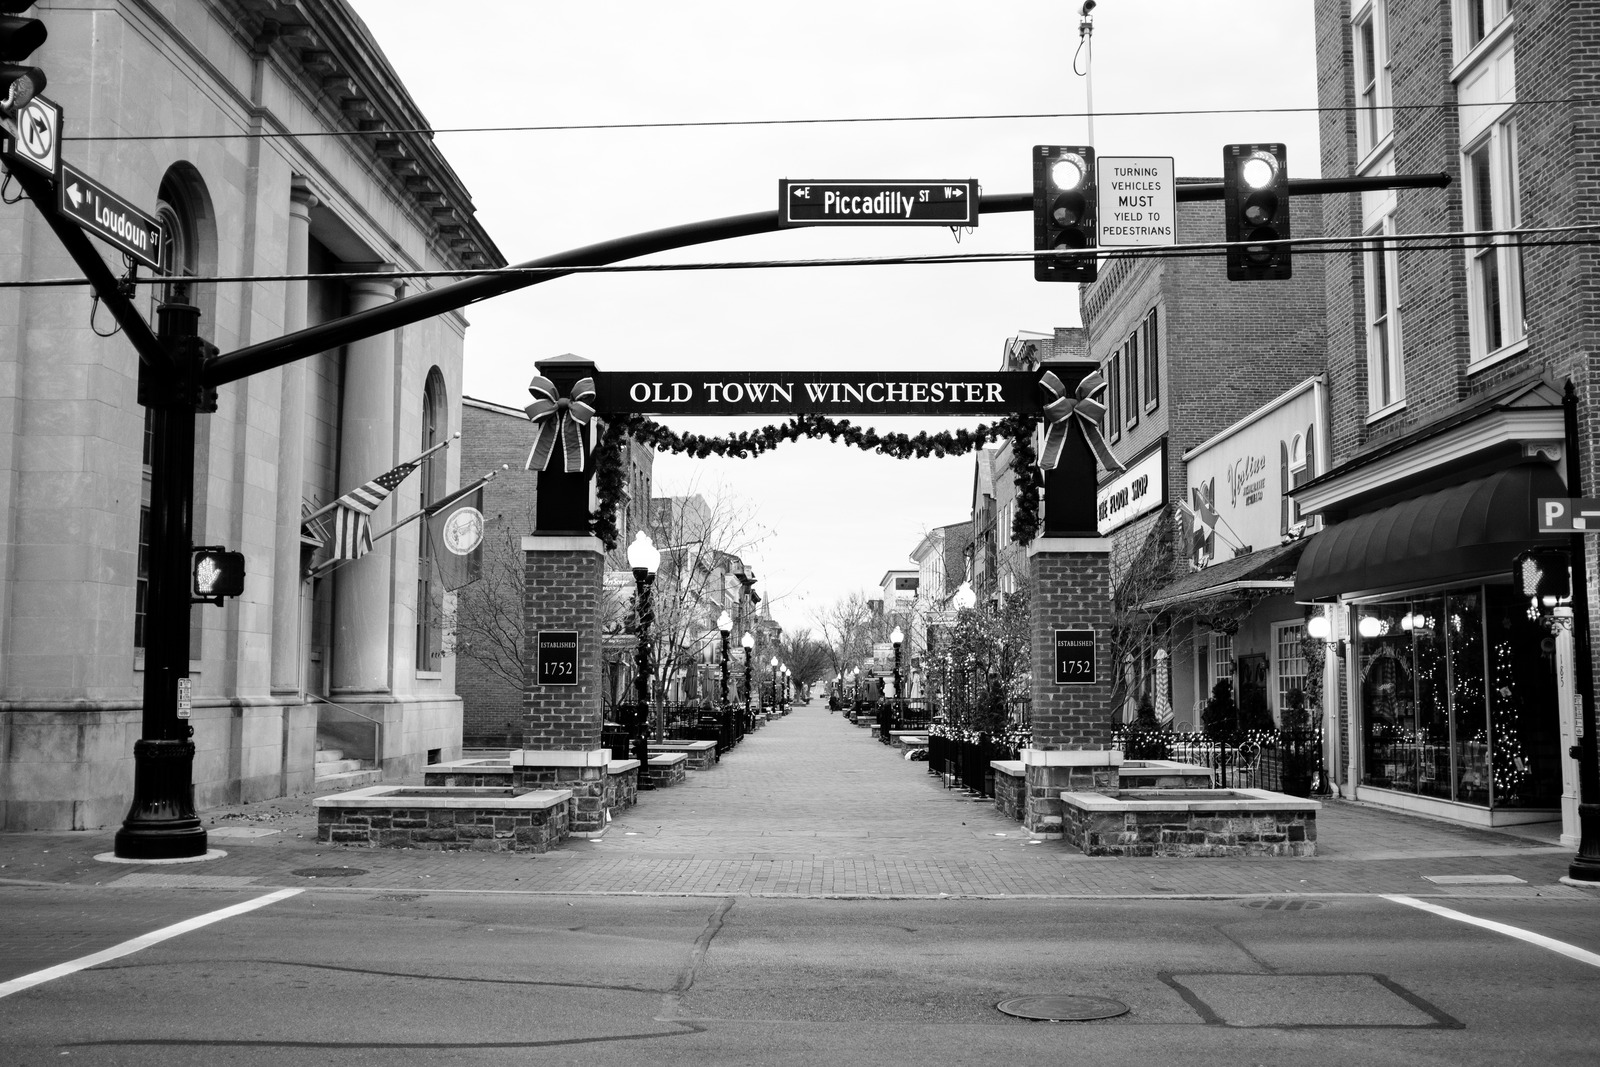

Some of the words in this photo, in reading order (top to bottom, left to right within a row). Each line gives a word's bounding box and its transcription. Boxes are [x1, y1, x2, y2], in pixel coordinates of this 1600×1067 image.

[1114, 167, 1158, 177] TURNING
[1111, 181, 1162, 191] VEHICLES
[805, 187, 810, 199] E
[824, 191, 915, 218] Piccadilly
[919, 190, 930, 202] ST
[944, 187, 953, 199] W
[1118, 195, 1154, 207] MUST
[86, 189, 92, 205] N
[95, 195, 147, 251] Loudoun
[150, 231, 159, 246] ST
[1114, 212, 1143, 222] YIELD
[1148, 212, 1160, 222] TO
[1103, 226, 1172, 236] PEDESTRIANS
[629, 382, 693, 403] OLD
[703, 382, 794, 403] TOWN
[804, 382, 1006, 403] WINCHESTER
[1109, 486, 1129, 515] FLOOR
[1131, 473, 1149, 501] SHOP
[1545, 501, 1565, 526] P
[540, 641, 576, 649] ESTABLISHED
[544, 661, 573, 676] 1752
[1062, 660, 1091, 675] 1752
